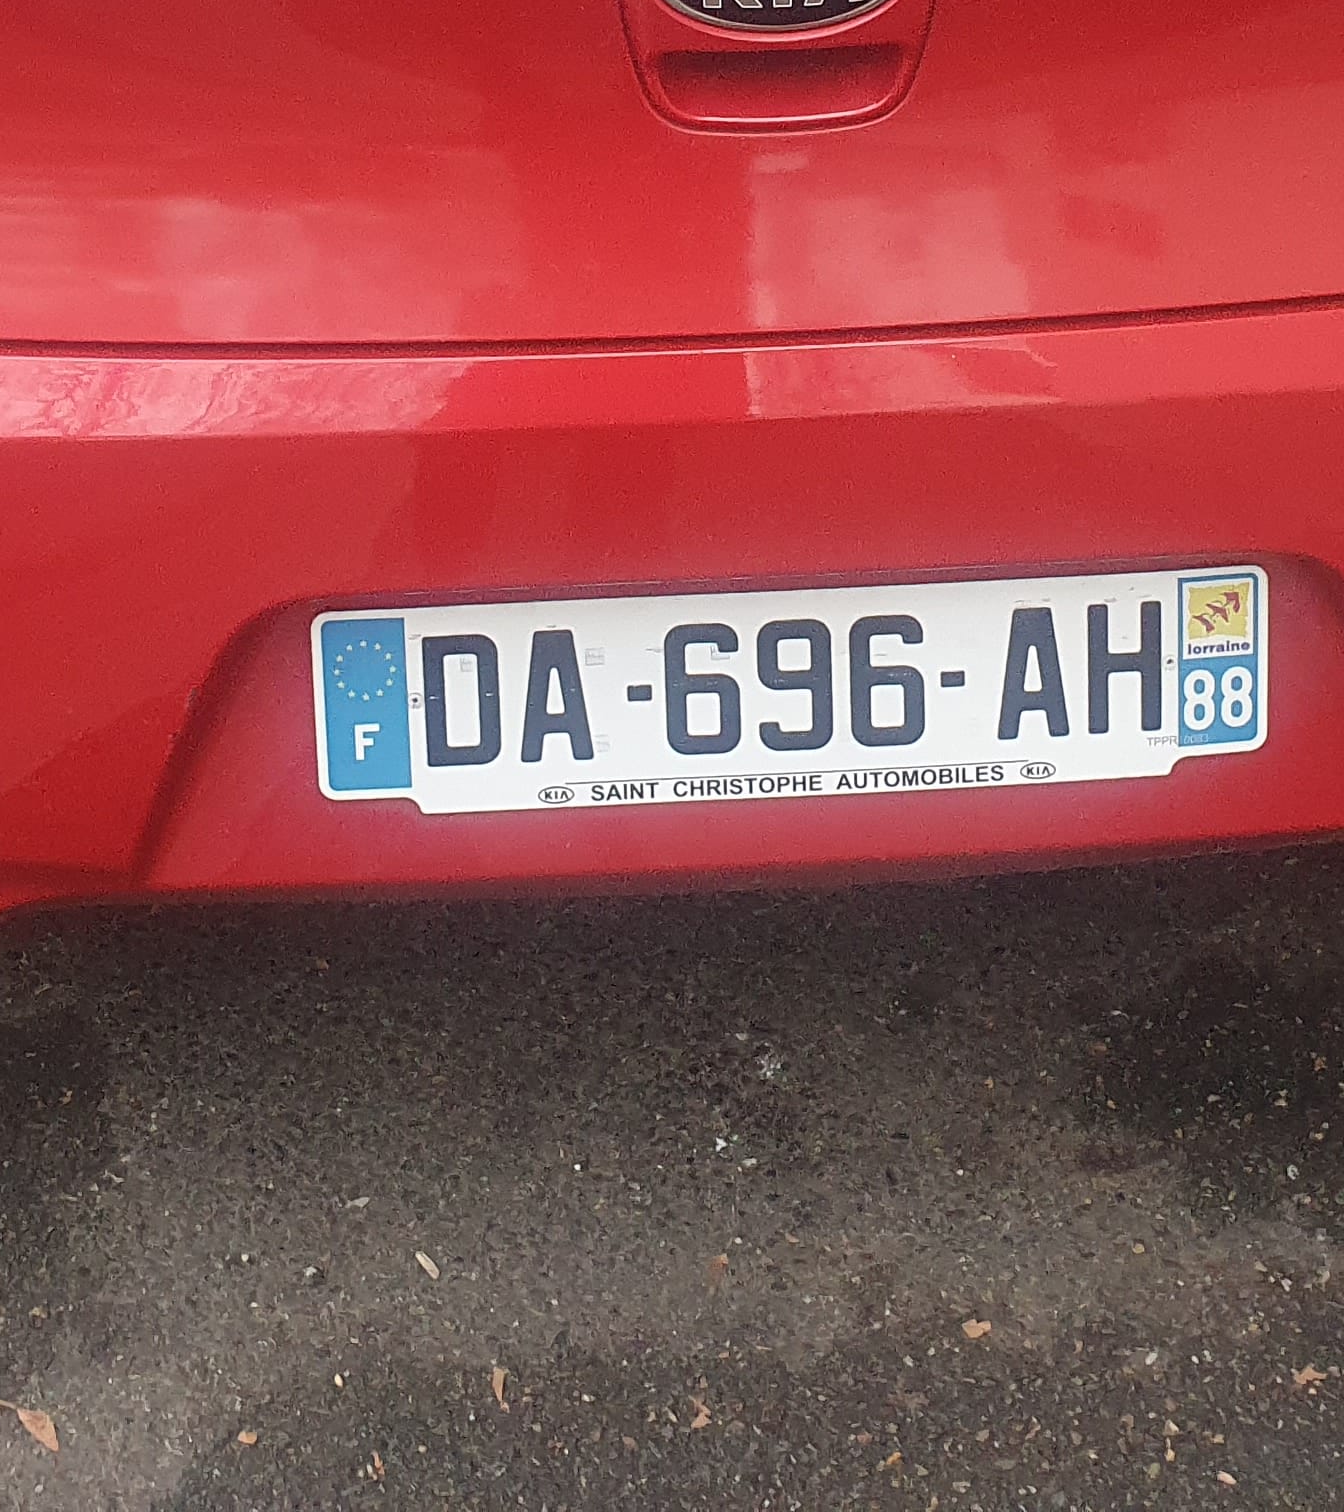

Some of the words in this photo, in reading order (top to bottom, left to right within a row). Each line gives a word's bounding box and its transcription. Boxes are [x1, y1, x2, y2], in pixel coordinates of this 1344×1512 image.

[1187, 640, 1251, 655] lorraine
[1183, 666, 1253, 731] 88
[354, 723, 380, 761] F
[591, 782, 659, 801] SAINT
[673, 773, 823, 797] CHRISTOPHE
[836, 764, 1005, 791] AUTOMOBILES
